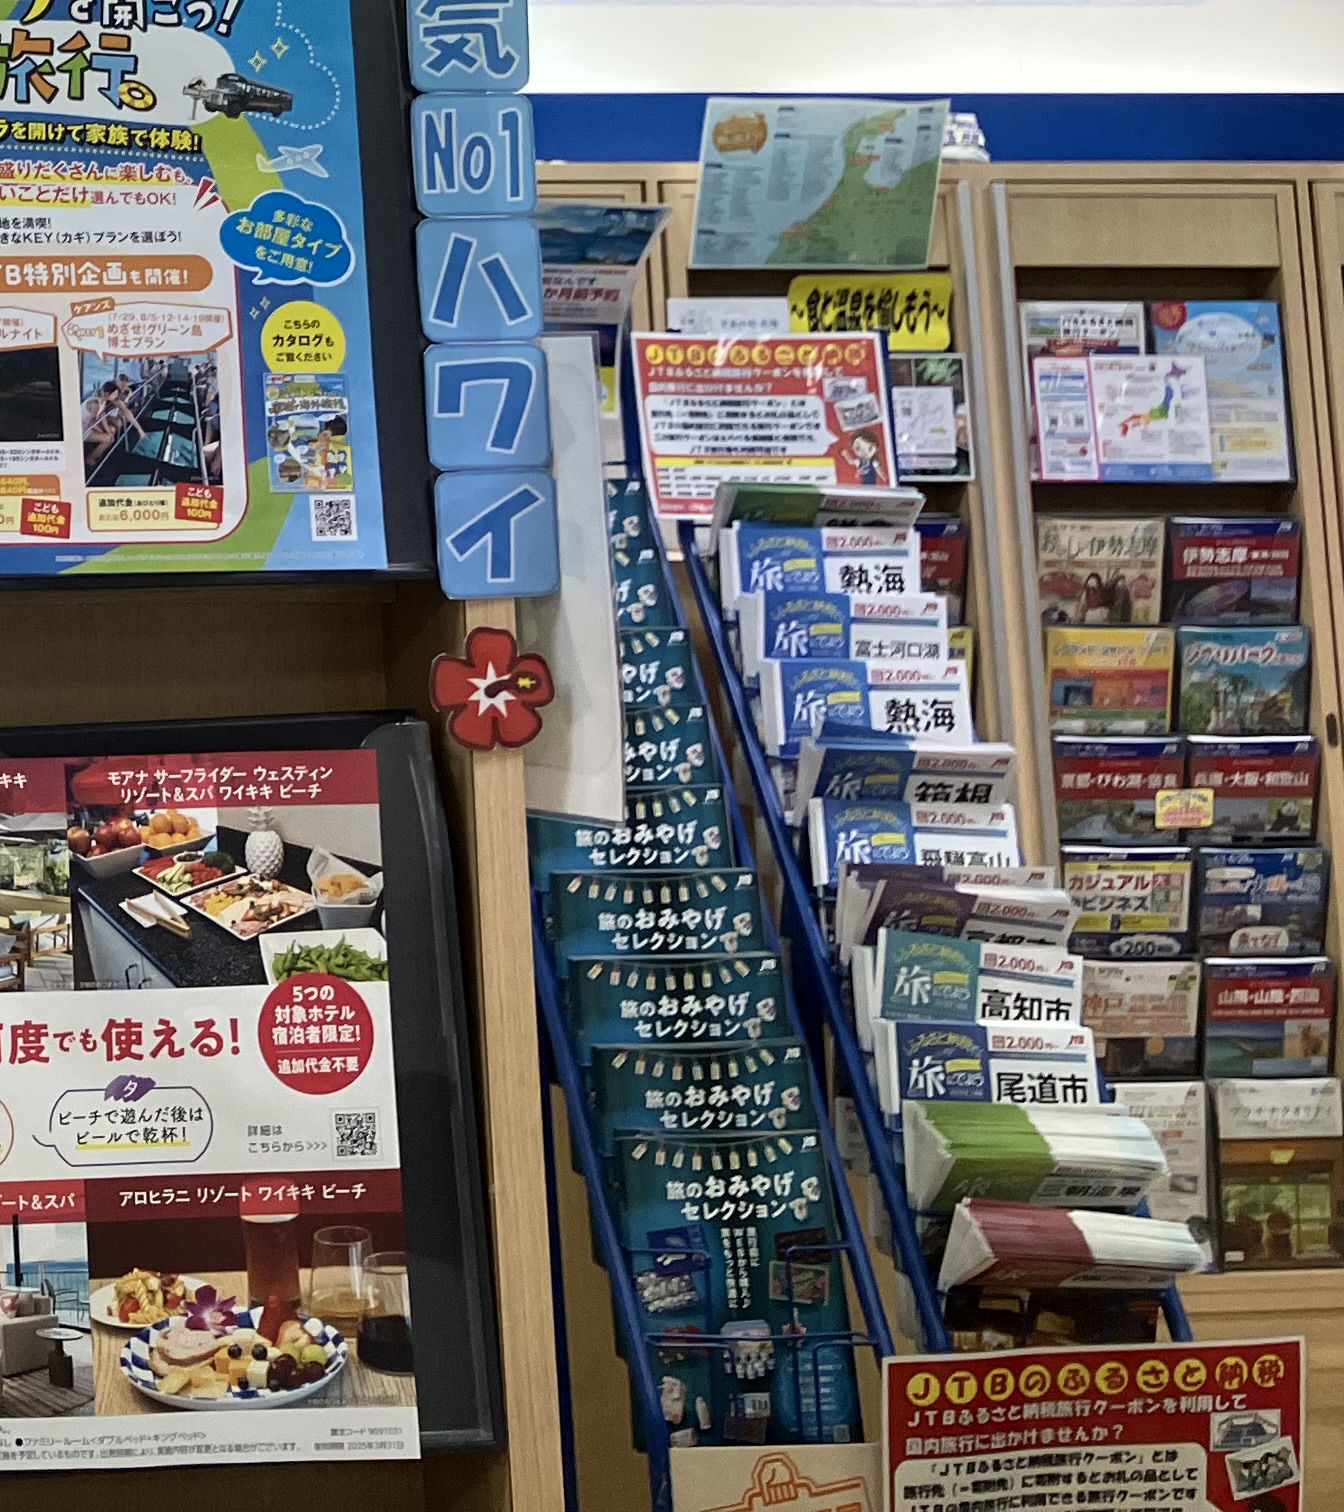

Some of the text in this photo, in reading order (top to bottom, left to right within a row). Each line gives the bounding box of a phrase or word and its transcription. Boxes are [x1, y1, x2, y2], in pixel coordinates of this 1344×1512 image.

[283, 319, 320, 330] こちらの
[272, 333, 334, 350] カタログも
[840, 564, 905, 594] 熱海
[885, 699, 956, 733] 熱海
[108, 766, 332, 786] モアナ サーフライダー ウェスティン
[219, 786, 273, 800] ワイキキ
[280, 783, 321, 798] ビーチ
[292, 987, 334, 1001] 5つの
[275, 1004, 354, 1021] 対象ホテル
[982, 989, 1072, 1021] 高知市
[272, 1024, 360, 1043] 宿泊者限定!
[278, 1057, 359, 1074] 追加代金不要
[997, 1072, 1088, 1103] 尾道市
[59, 1107, 203, 1125] ビーチで遊んだ後は
[120, 1183, 366, 1206] アロヒラニ リゾート ワイキキ ビーチ
